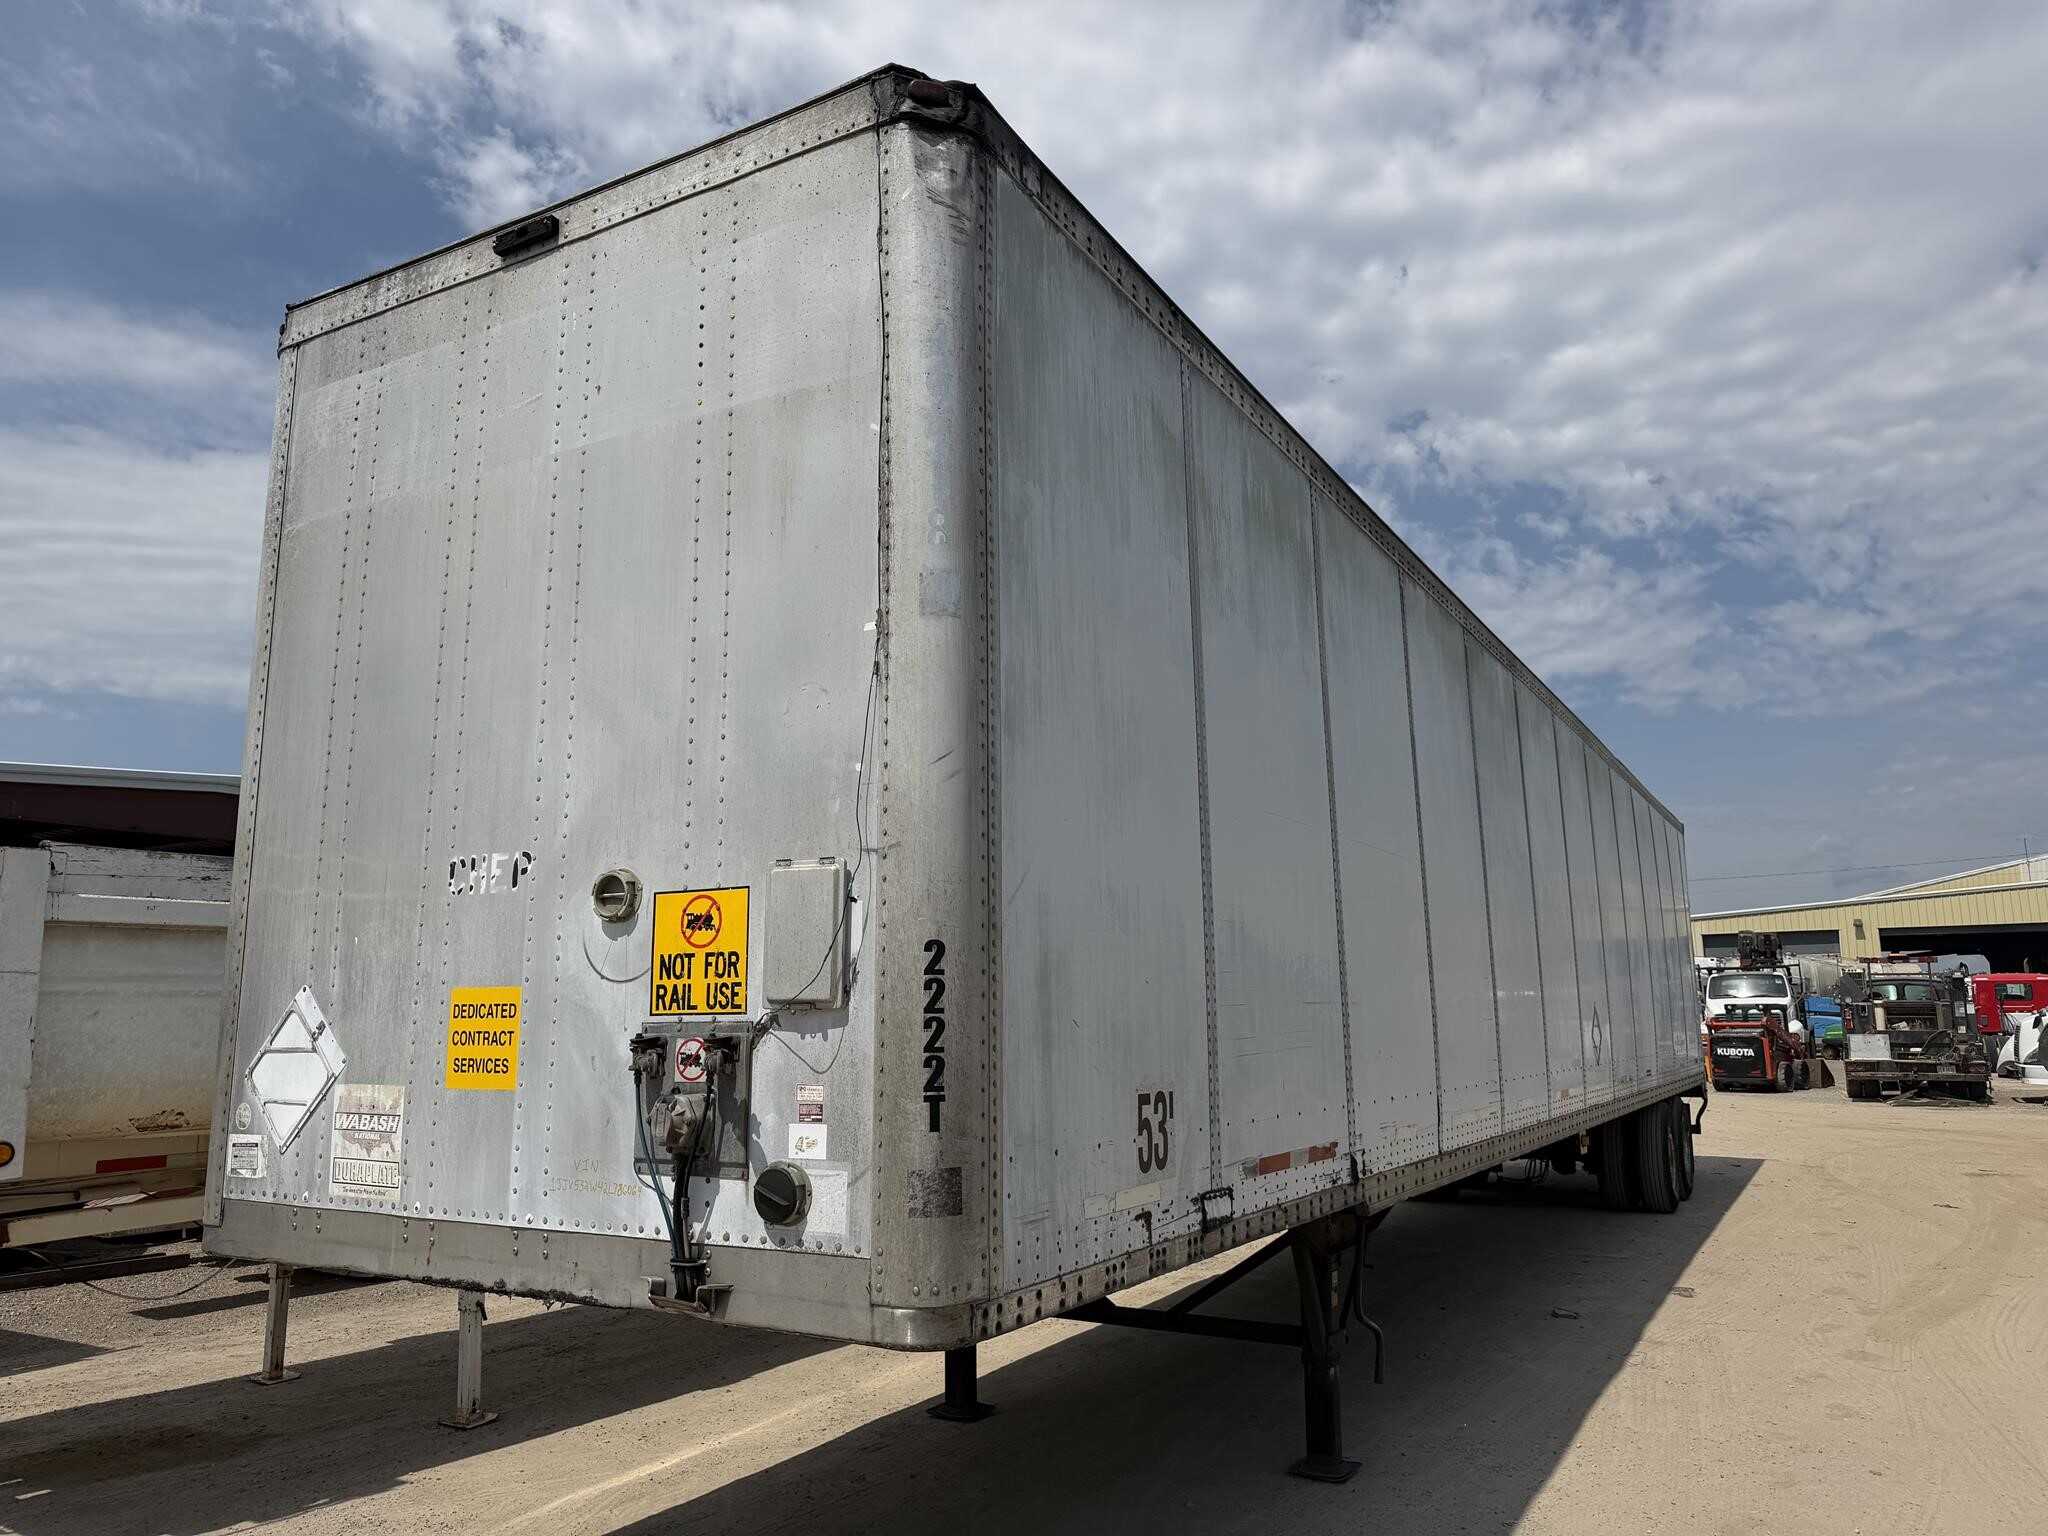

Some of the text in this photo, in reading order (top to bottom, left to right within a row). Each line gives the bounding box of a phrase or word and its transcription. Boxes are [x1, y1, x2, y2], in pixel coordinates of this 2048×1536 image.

[659, 951, 740, 980] NOT FOR
[655, 982, 742, 1010] RAIL USE
[453, 1003, 517, 1019] DEDICATED
[452, 1030, 515, 1046] CONTRACT
[1717, 1047, 1755, 1057] KUBOTA
[453, 1057, 509, 1074] SERVICES
[336, 1113, 399, 1131] WABASH
